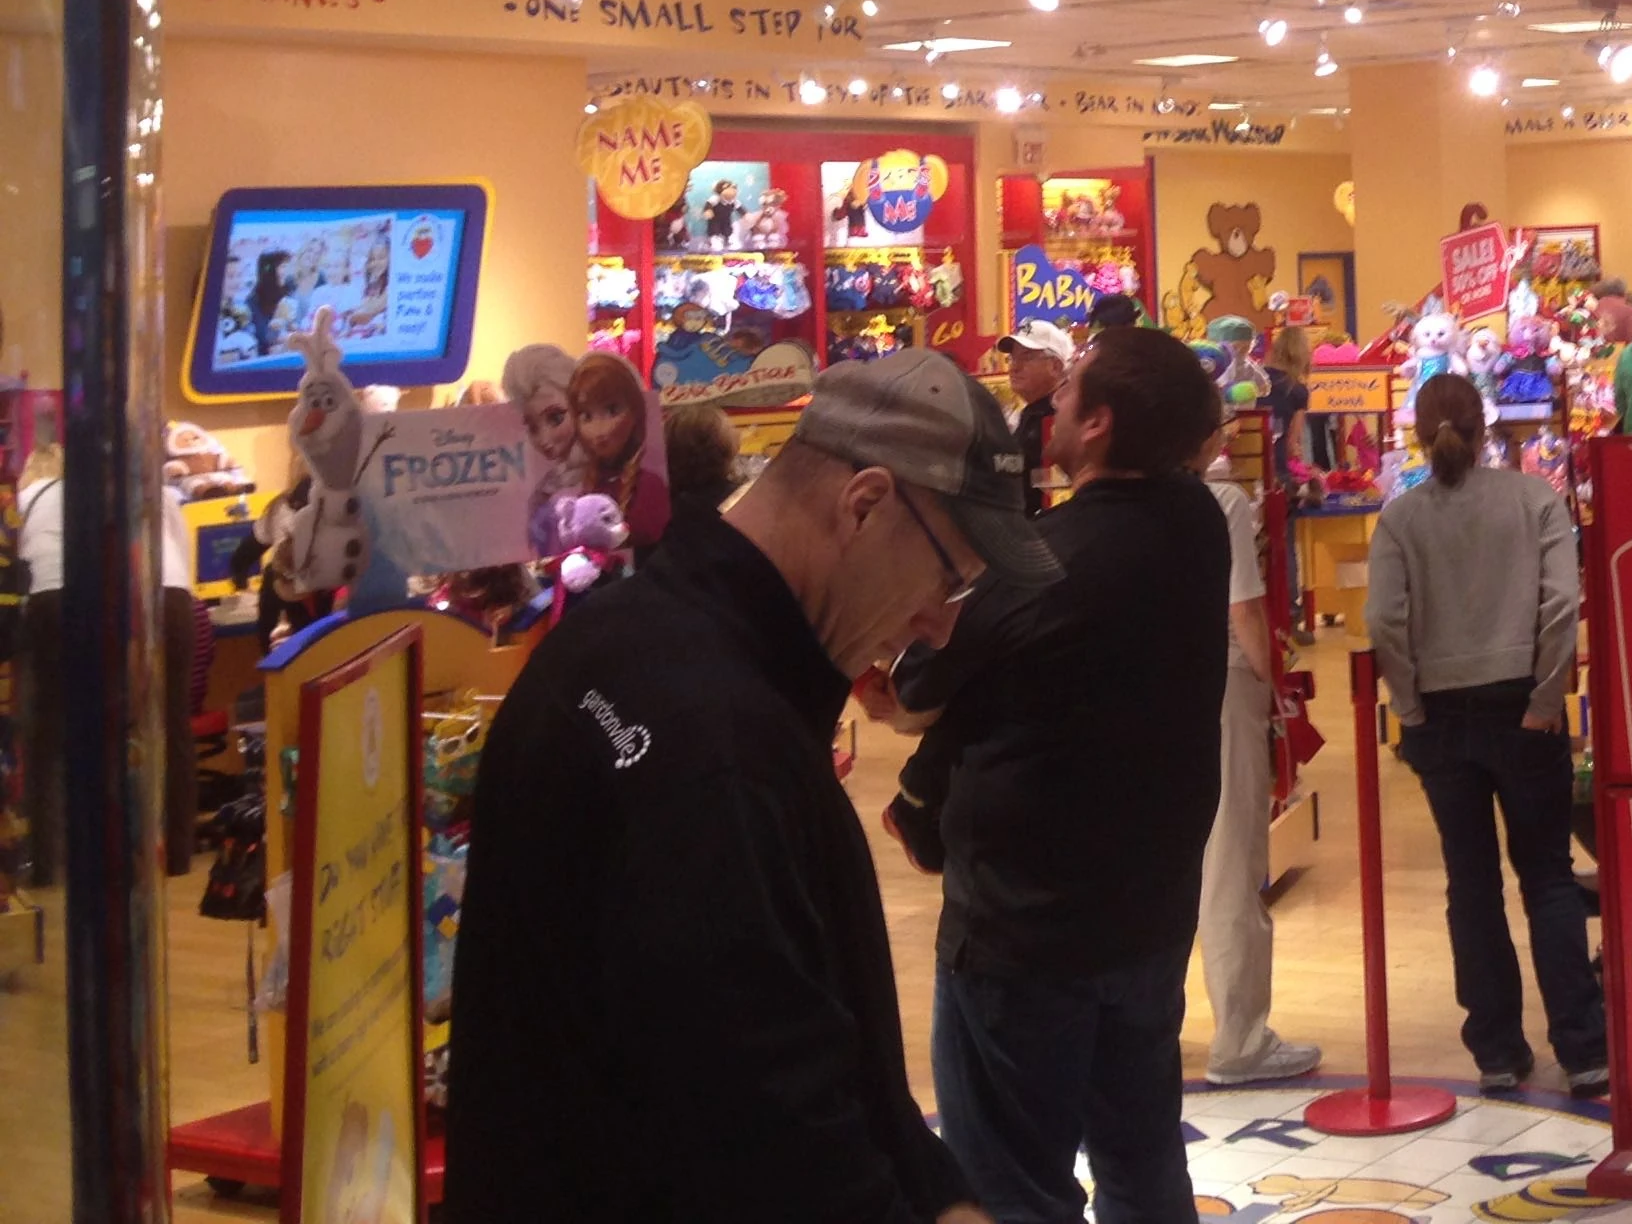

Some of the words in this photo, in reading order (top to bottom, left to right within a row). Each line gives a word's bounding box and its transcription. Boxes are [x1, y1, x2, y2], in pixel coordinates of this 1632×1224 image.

[730, 8, 800, 38] STEP
[597, 122, 682, 152] NAME
[619, 157, 661, 187] ME
[383, 441, 526, 498] FROZEN
